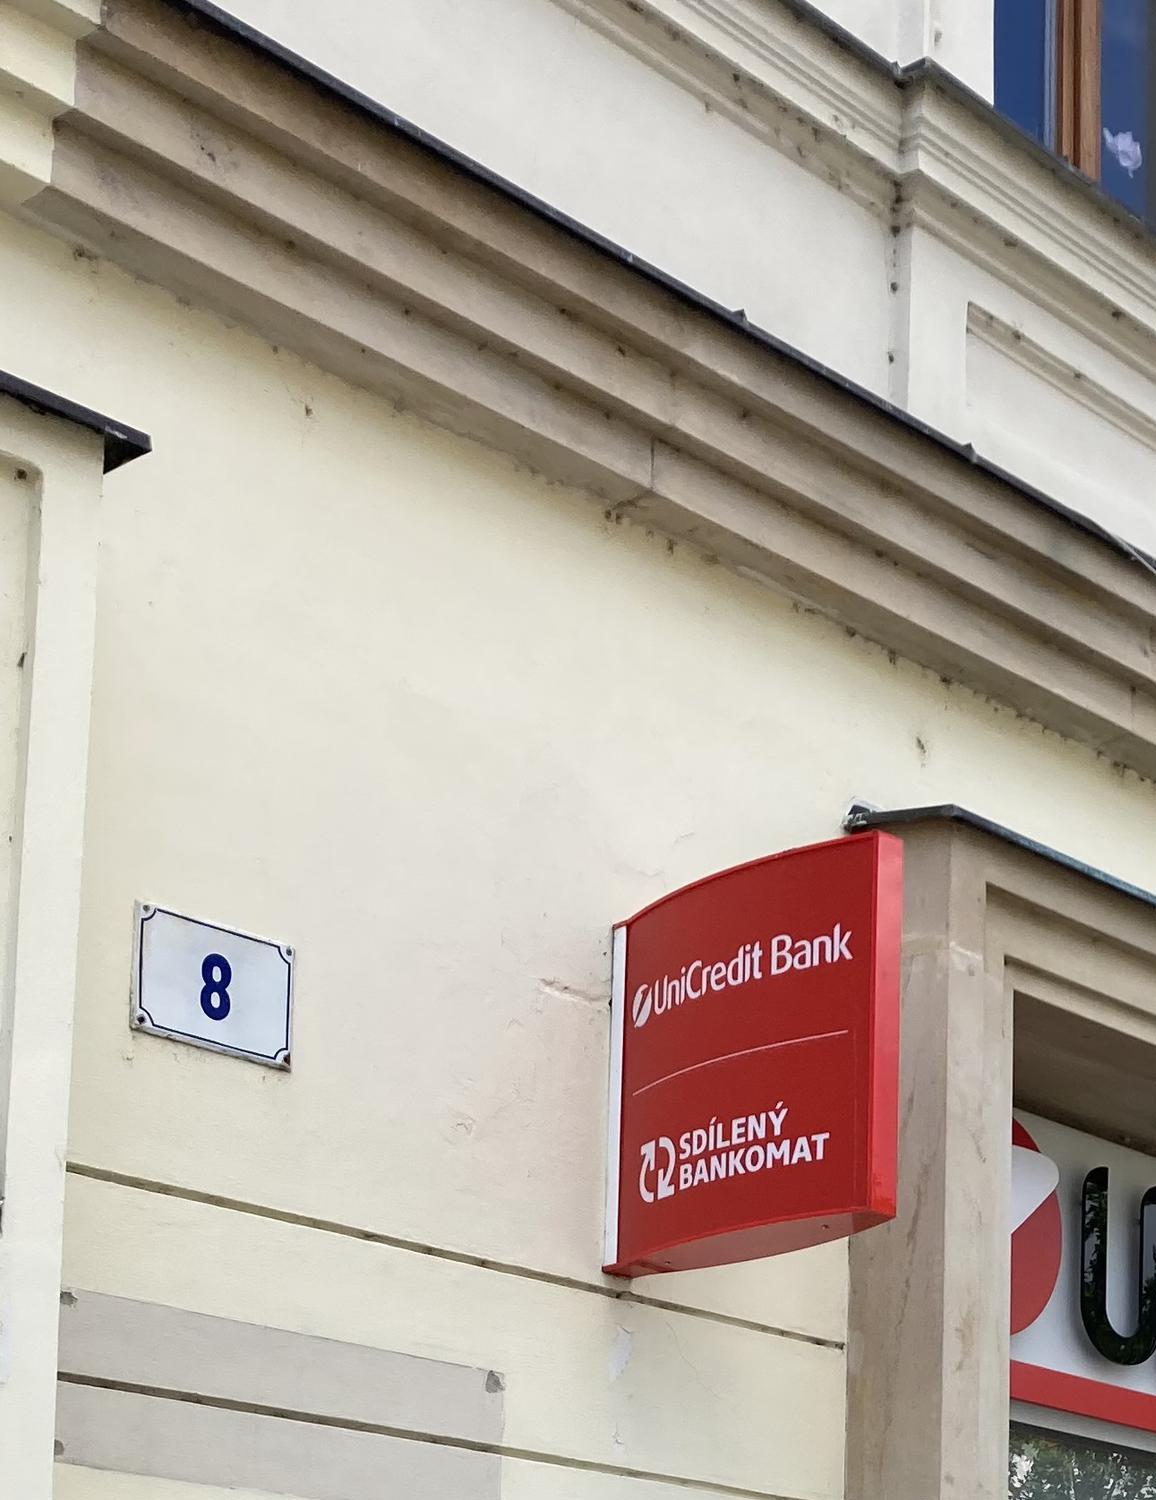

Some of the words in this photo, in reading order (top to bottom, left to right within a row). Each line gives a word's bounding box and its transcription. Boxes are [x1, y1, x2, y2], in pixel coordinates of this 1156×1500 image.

[200, 953, 232, 1021] 8
[653, 940, 763, 1016] UniCredit
[770, 922, 854, 975] Bank
[679, 1101, 788, 1155] SDÍLENÝ
[679, 1131, 830, 1192] BANKOMAT
